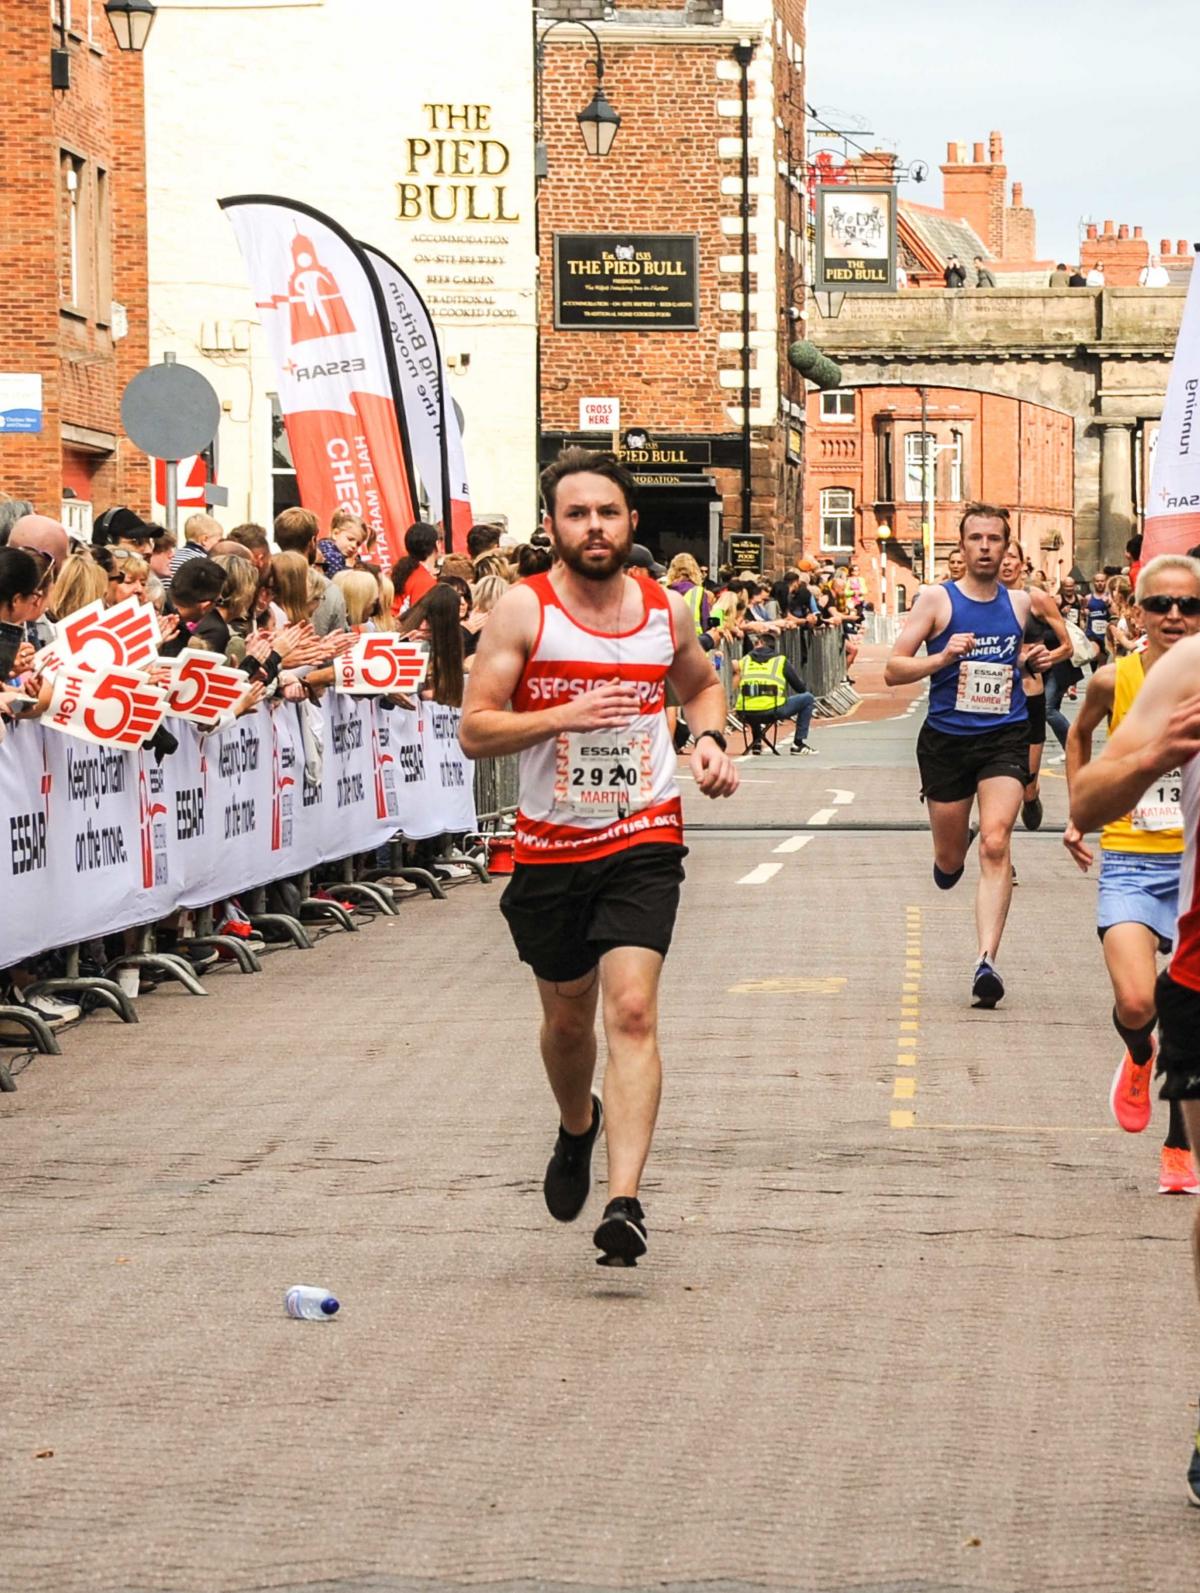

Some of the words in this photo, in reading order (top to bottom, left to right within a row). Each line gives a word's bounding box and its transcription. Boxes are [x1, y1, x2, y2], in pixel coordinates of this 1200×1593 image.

[423, 103, 491, 131] THE
[404, 138, 510, 177] PIED
[394, 182, 520, 224] BULL
[410, 234, 509, 245] ACCOMMODATION
[567, 261, 601, 275] THE
[604, 261, 640, 275] PIED
[644, 261, 687, 275] BULL
[847, 260, 865, 268] THE
[426, 275, 450, 284] BEER
[452, 275, 495, 285] GARDEN
[826, 268, 853, 279] PIED
[855, 269, 886, 280] BULL
[586, 405, 612, 414] CROSS
[589, 415, 609, 424] HERE
[619, 450, 649, 462] PIED
[652, 450, 688, 462] BULL
[361, 639, 398, 688] 5
[169, 657, 216, 712] 5
[975, 682, 1000, 694] 108
[53, 676, 83, 725] HIGH
[84, 673, 140, 739] 5
[580, 746, 630, 756] ESSAR
[572, 767, 637, 786] 2920
[580, 791, 630, 803] MARTIN
[176, 787, 205, 840] ESSAR
[1140, 807, 1180, 817] KATARZ
[10, 812, 47, 875] ESSAR
